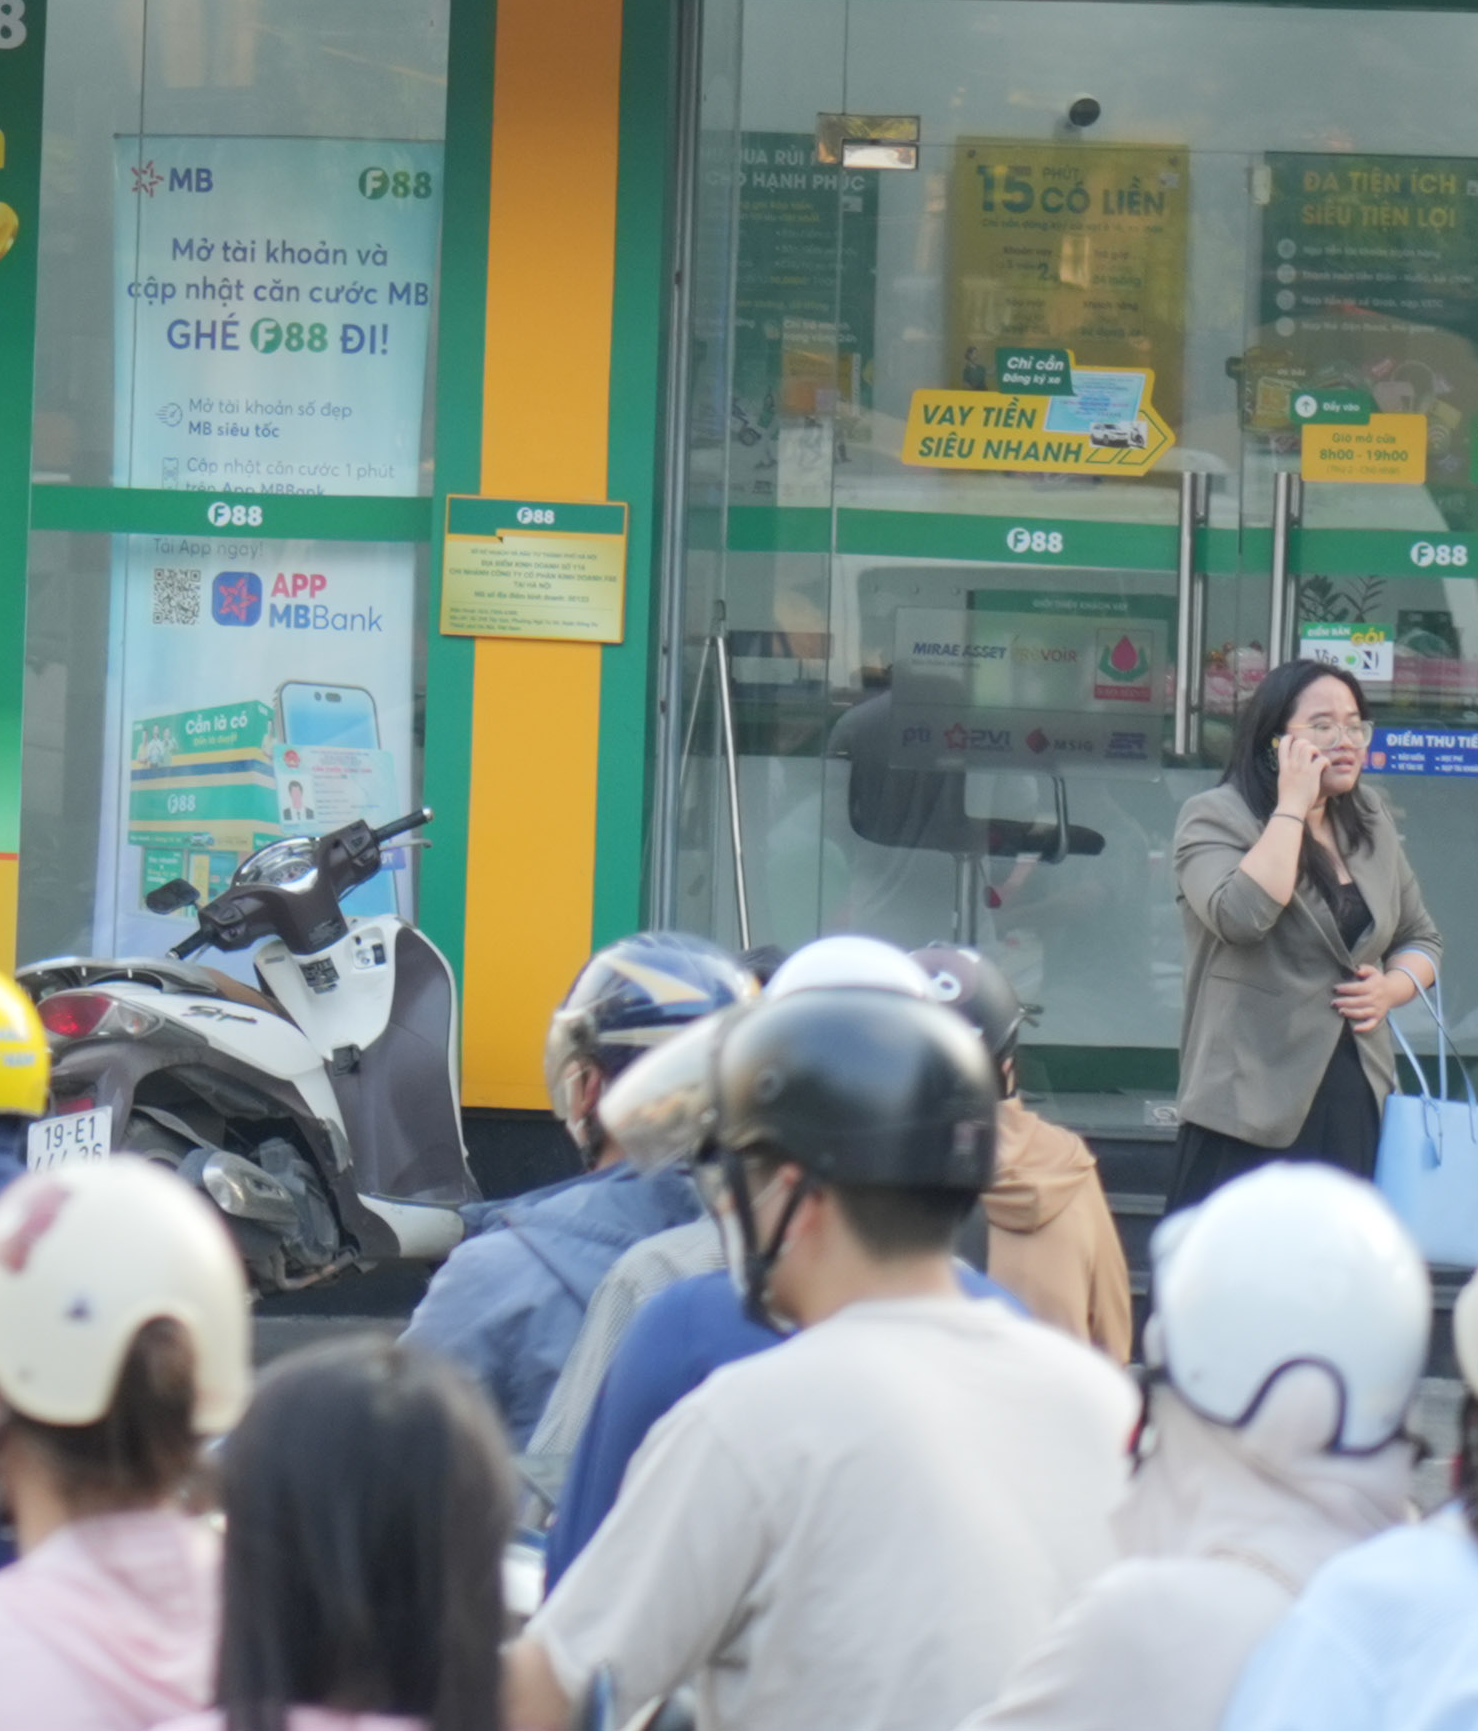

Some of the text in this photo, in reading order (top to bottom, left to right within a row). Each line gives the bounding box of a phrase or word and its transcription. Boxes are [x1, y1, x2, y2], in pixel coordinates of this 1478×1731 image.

[168, 168, 213, 193] MB
[172, 237, 388, 267] Mở tài khoản và
[127, 276, 429, 307] cập nhật căn cước MB
[167, 313, 389, 355] GHÉ F88 ĐI!
[1007, 355, 1064, 371] Chỉ cần
[923, 397, 1037, 429] VAY TIỀN
[918, 432, 1082, 463] SIÊU NHANH
[1320, 449, 1408, 462] 8h00 19h00
[1007, 527, 1063, 554] F88
[271, 573, 327, 598] APP
[269, 604, 383, 633] MBBank
[45, 1116, 95, 1150] 19-E1
